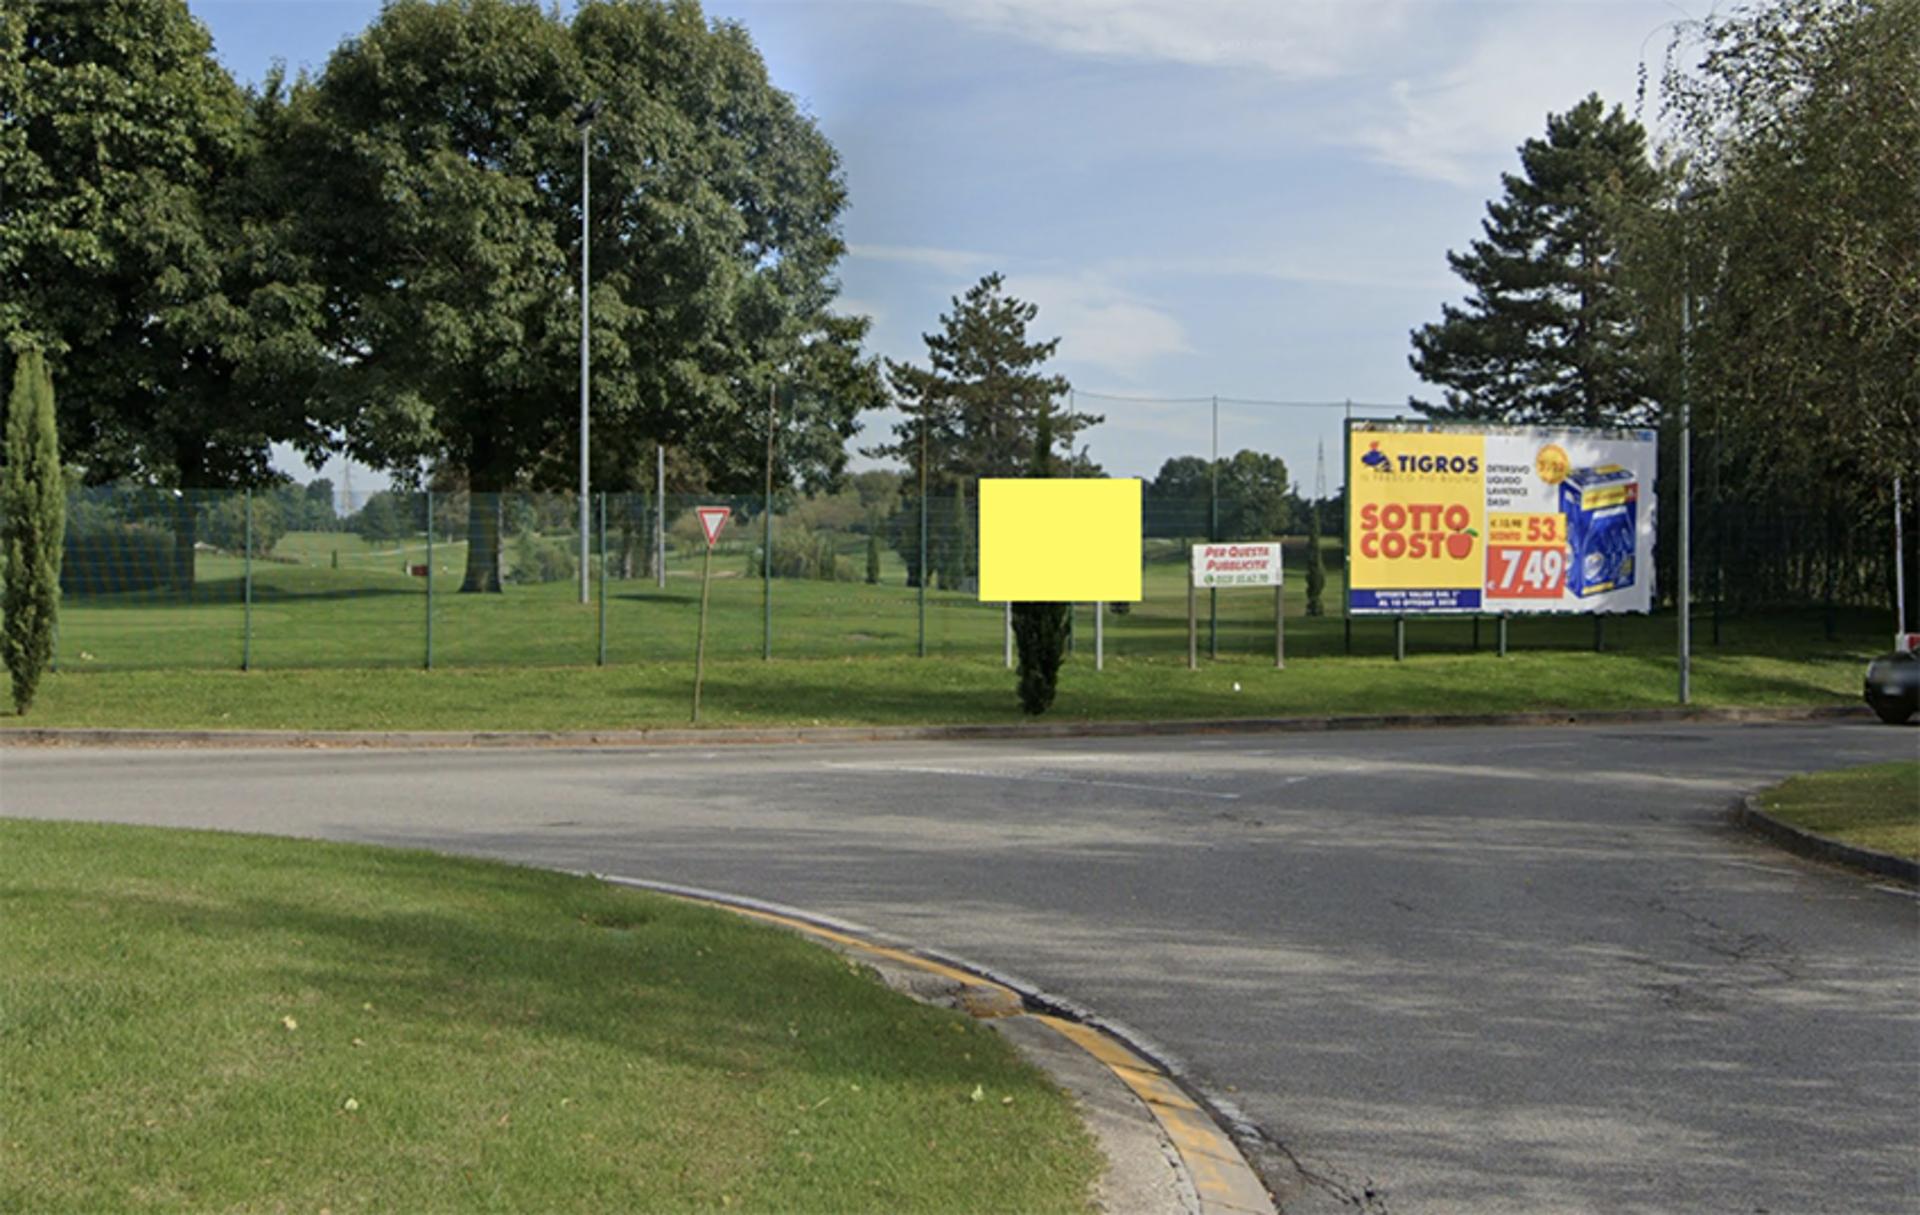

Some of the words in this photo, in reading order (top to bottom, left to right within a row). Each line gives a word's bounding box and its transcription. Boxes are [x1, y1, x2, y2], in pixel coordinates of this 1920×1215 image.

[1398, 455, 1478, 474] TIGROS
[1487, 476, 1522, 485] LIQUIDO
[1487, 487, 1528, 496] LAVATRICE
[1361, 504, 1469, 530] SOTTO
[1500, 549, 1563, 593] 7,49
